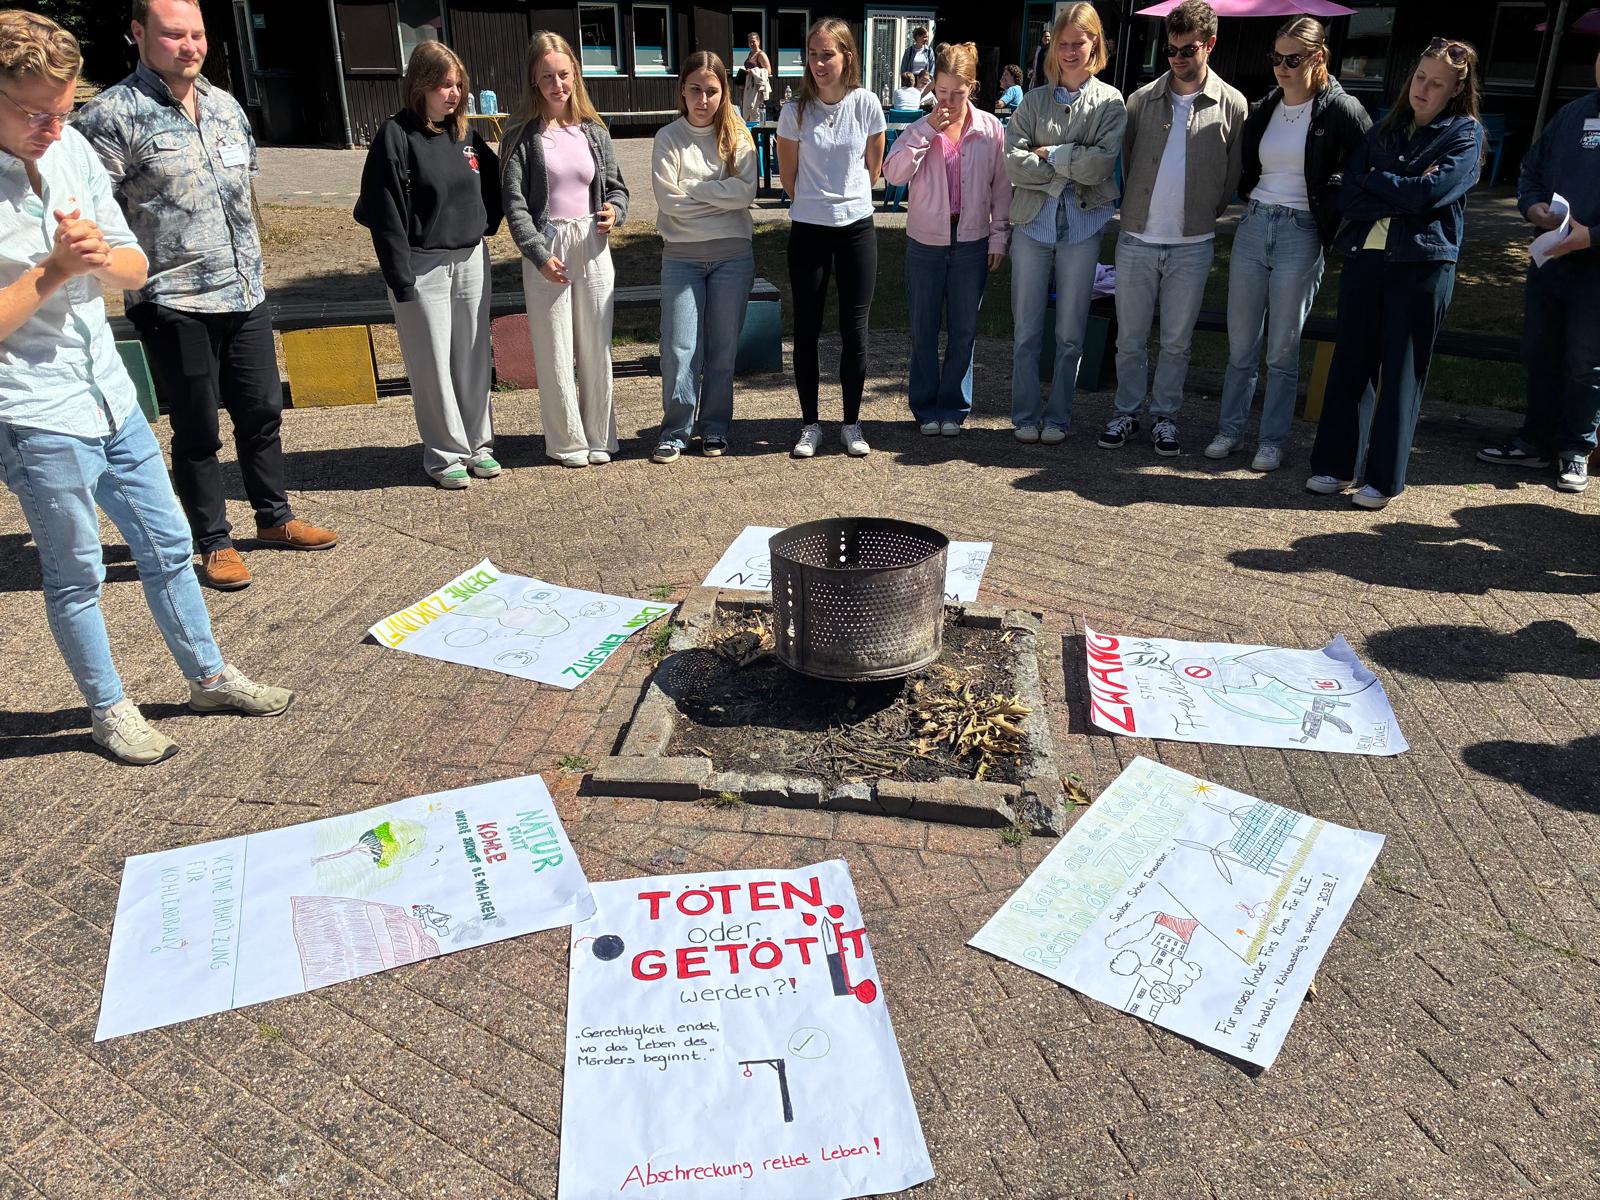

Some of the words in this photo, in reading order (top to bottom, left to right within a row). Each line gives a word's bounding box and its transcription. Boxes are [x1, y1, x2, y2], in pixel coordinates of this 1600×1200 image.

[444, 570, 498, 602] DEINE
[373, 595, 459, 647] ZUKUNFT
[622, 607, 667, 628] DEIN
[561, 633, 630, 678] EINSATZ
[1087, 634, 1136, 732] ZWANG
[1135, 675, 1155, 700] STATT
[455, 809, 471, 834] UNSERE
[463, 837, 481, 863] ZUKUNFT
[476, 822, 506, 864] KOHLE
[507, 826, 529, 850] STATT
[516, 809, 565, 873] NATUR
[186, 860, 207, 883] FÜR
[212, 854, 233, 894] KEINE
[1010, 874, 1071, 918] Raus
[1065, 844, 1093, 872] aus
[1081, 822, 1113, 842] der
[638, 877, 823, 920] TÖTEN
[210, 898, 234, 970] ABHOLZUNG
[688, 920, 761, 944] oder
[1023, 932, 1081, 970] Rein
[1057, 912, 1096, 929] in
[1080, 878, 1120, 909] die
[1215, 1017, 1238, 1035] Für
[1233, 989, 1255, 1014] unsere
[1258, 940, 1279, 959] Fürs
[1282, 898, 1299, 911] Für
[1241, 1031, 1261, 1052] Jetzt
[1254, 997, 1279, 1029] handeln
[1296, 934, 1309, 946] bis
[577, 1055, 635, 1066] Mörders
[580, 1045, 597, 1053] wo
[605, 1043, 628, 1052] das
[638, 1039, 676, 1050] Leben
[684, 1037, 708, 1046] des
[620, 1162, 753, 1191] Abschreckung
[763, 1153, 811, 1170] rettet
